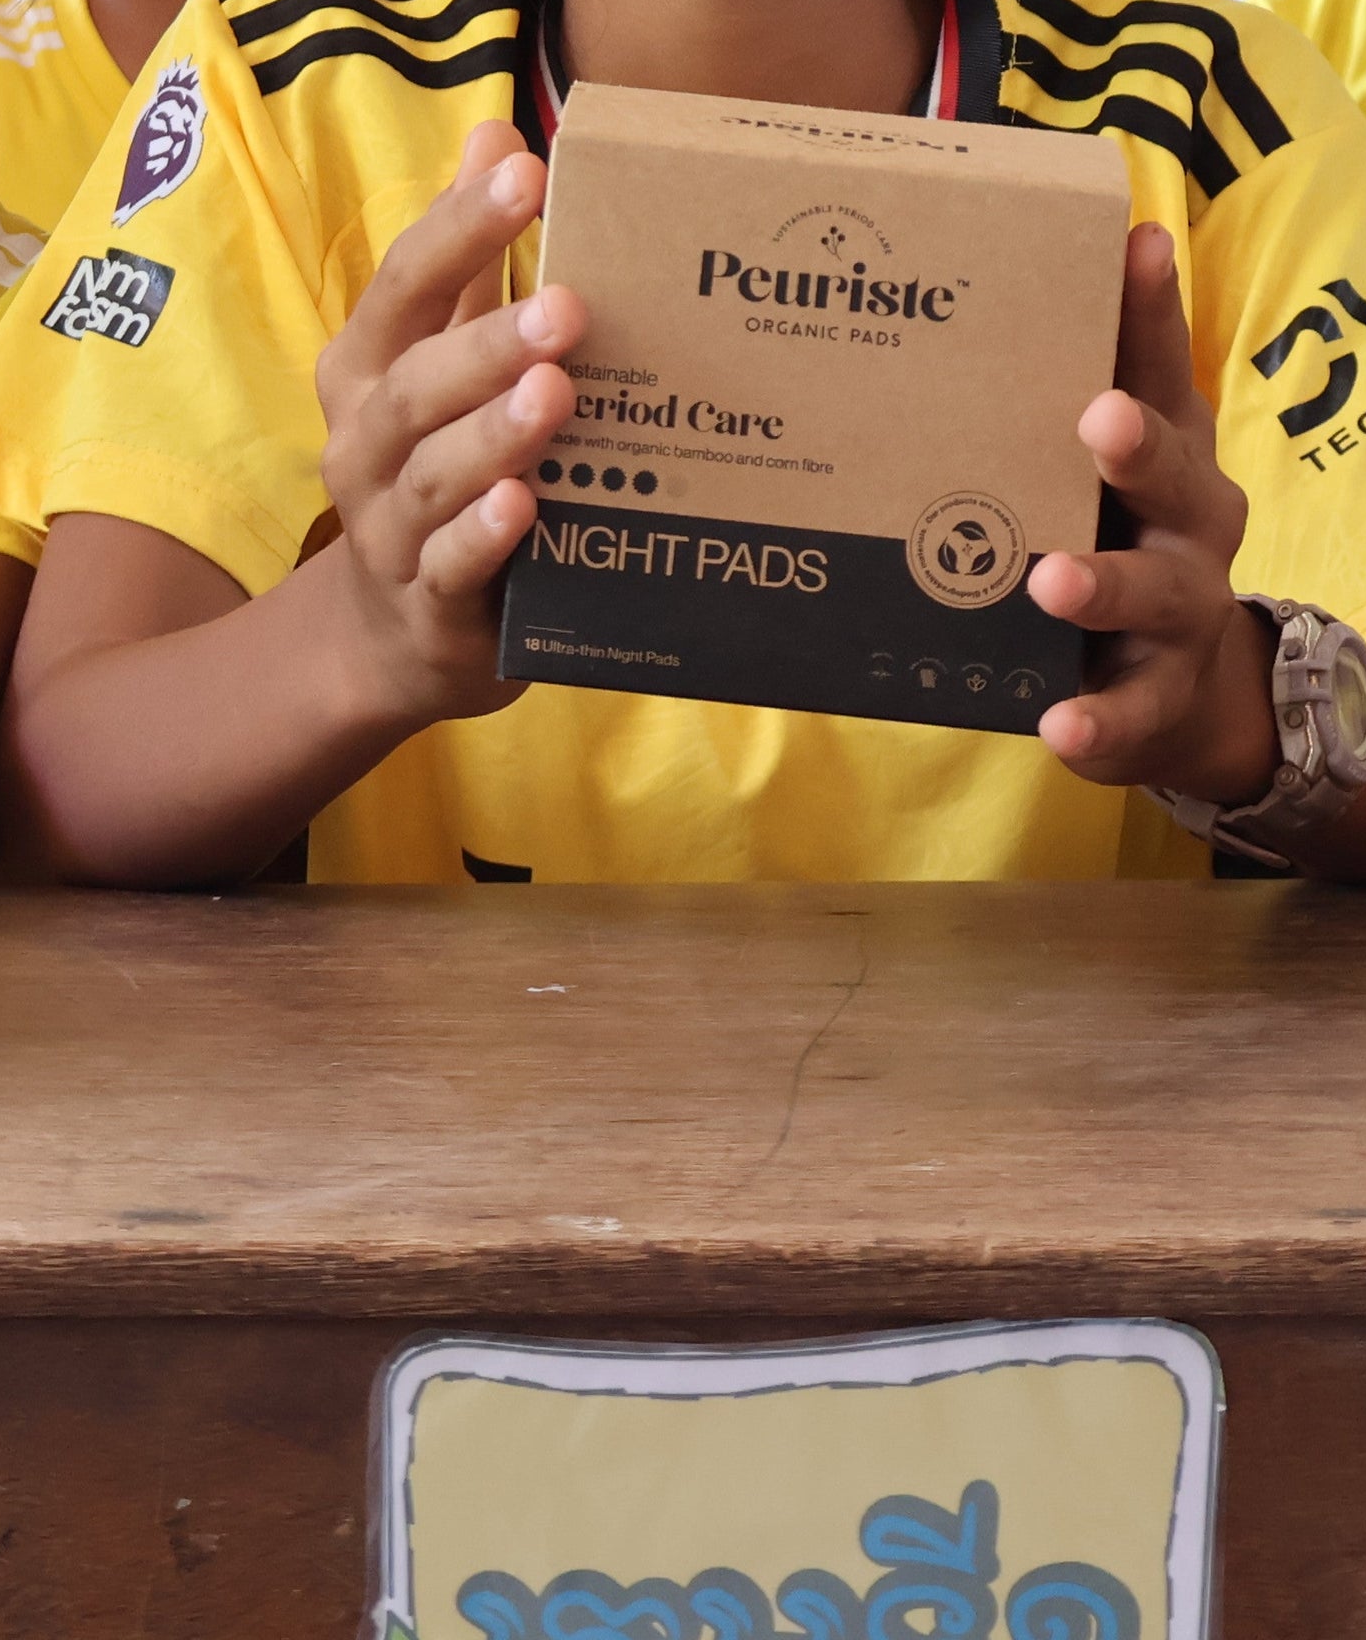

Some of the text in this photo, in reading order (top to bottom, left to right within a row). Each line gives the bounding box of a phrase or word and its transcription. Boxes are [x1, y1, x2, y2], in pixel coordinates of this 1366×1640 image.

[773, 204, 892, 256] SUSTAINABLE PERIOD CARE
[745, 316, 901, 347] ORGANIC PADS
[562, 362, 658, 387] ustainable
[574, 389, 783, 440] eriod Care
[551, 432, 833, 475] ade with organic bamboo and corn fibre
[531, 519, 829, 593] NIGHT PADS
[524, 637, 682, 667] 18 Ultra-thin Night Pads
